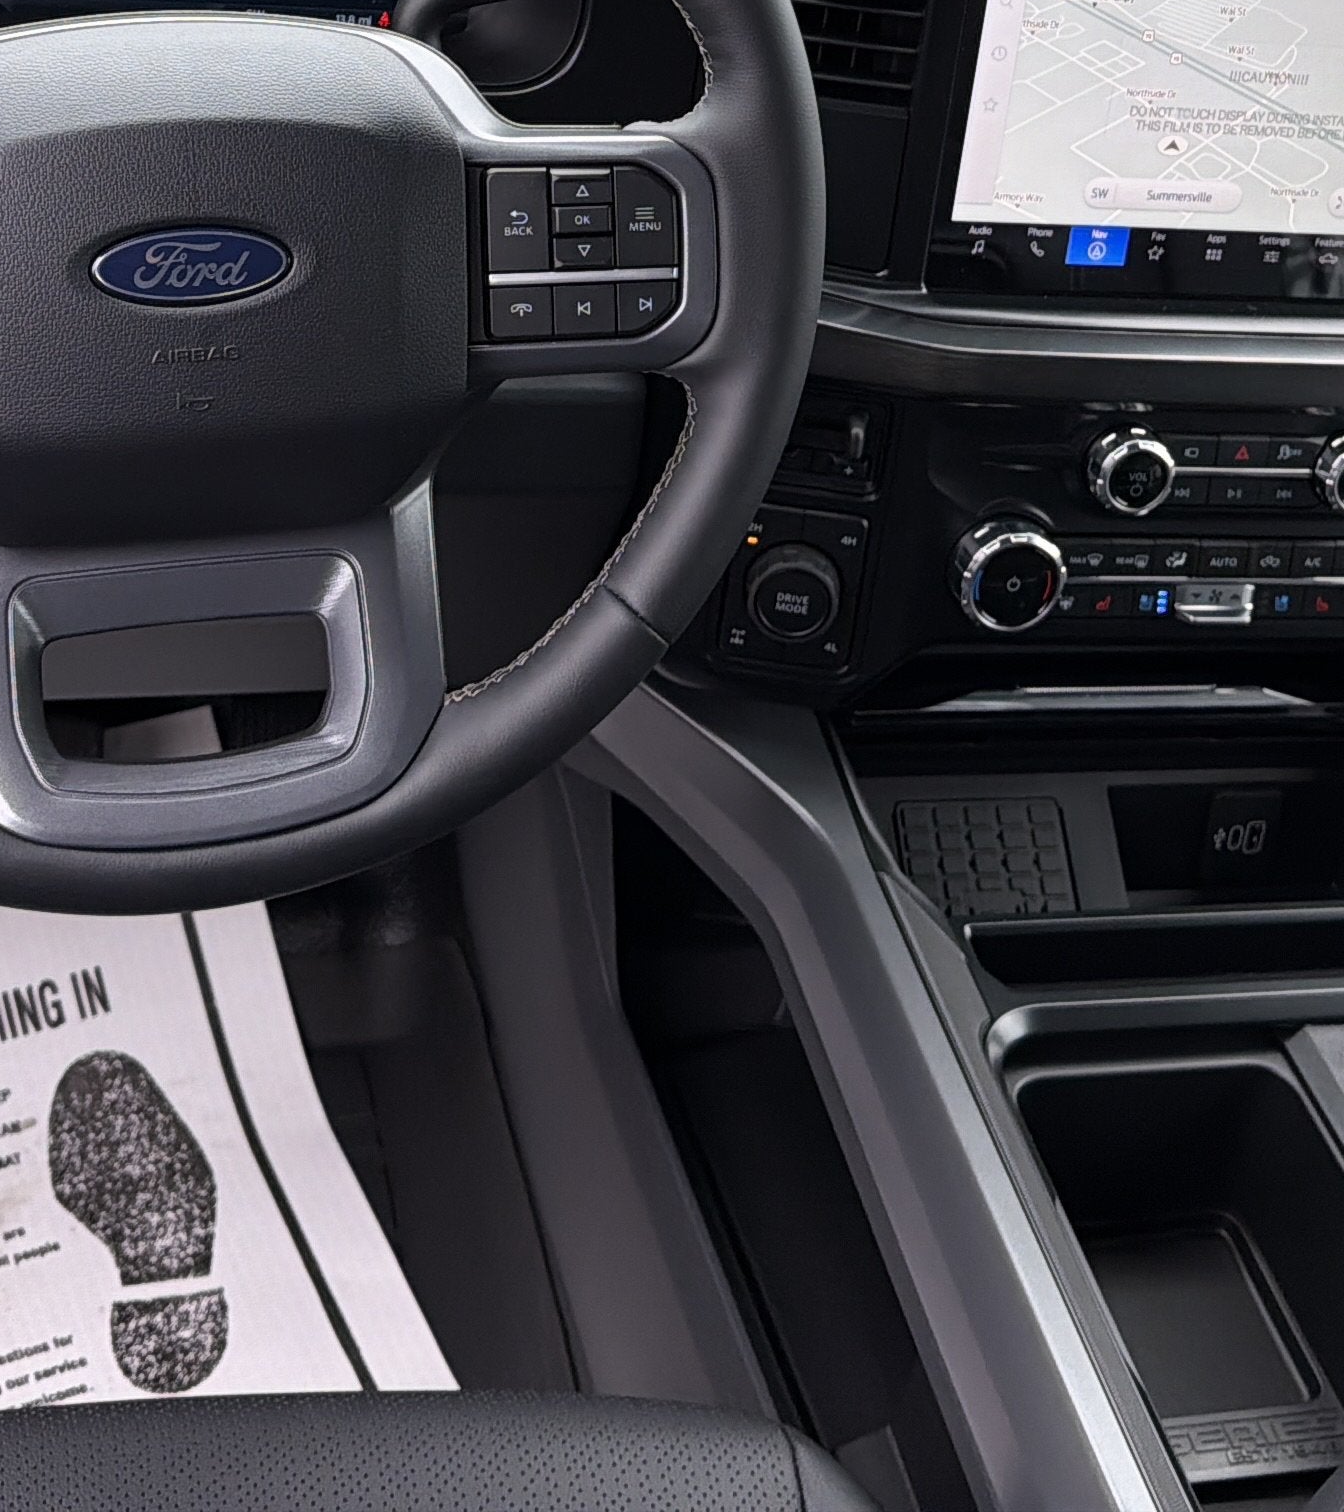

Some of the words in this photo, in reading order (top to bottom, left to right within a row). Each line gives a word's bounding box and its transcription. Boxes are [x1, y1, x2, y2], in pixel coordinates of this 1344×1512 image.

[1219, 6, 1233, 16] Wal
[1234, 6, 1246, 17] St
[1228, 45, 1242, 55] Wal
[1242, 45, 1255, 56] St
[1126, 87, 1166, 99] Northside
[1129, 105, 1147, 118] DO
[1149, 106, 1174, 118] NOT
[1175, 107, 1216, 120] TOUCH
[1217, 108, 1265, 123] DISPLAY
[1266, 111, 1311, 126] DURING
[1136, 119, 1161, 131] THIS
[1162, 119, 1190, 132] FILM
[1191, 122, 1203, 133] IS
[1205, 122, 1220, 134] TO
[1223, 123, 1238, 135] BE
[1239, 124, 1296, 139] REMOVED
[1297, 127, 1342, 140] BEFORE
[994, 190, 1023, 203] Armory
[1024, 192, 1044, 204] Way
[1091, 187, 1109, 199] SW
[1146, 189, 1213, 203] Summersville
[574, 215, 591, 225] OK
[504, 226, 534, 237] BACK
[628, 221, 662, 232] MENU
[968, 225, 992, 236] Audio
[1027, 227, 1054, 237] Phone
[1092, 228, 1109, 238] Nav
[1206, 233, 1227, 244] Apps
[1258, 234, 1290, 247] Settings
[133, 241, 251, 289] Ford
[151, 345, 240, 364] AIRBAG
[1129, 472, 1148, 482] VOL
[840, 535, 857, 547] 4H
[1209, 557, 1238, 568] AUTO
[777, 592, 810, 605] DRIVE
[775, 602, 808, 615] MODE
[70, 966, 113, 1021] IN
[3, 1226, 26, 1241] are
[52, 1334, 74, 1349] for
[6, 1374, 30, 1390] our
[34, 1356, 88, 1381] service
